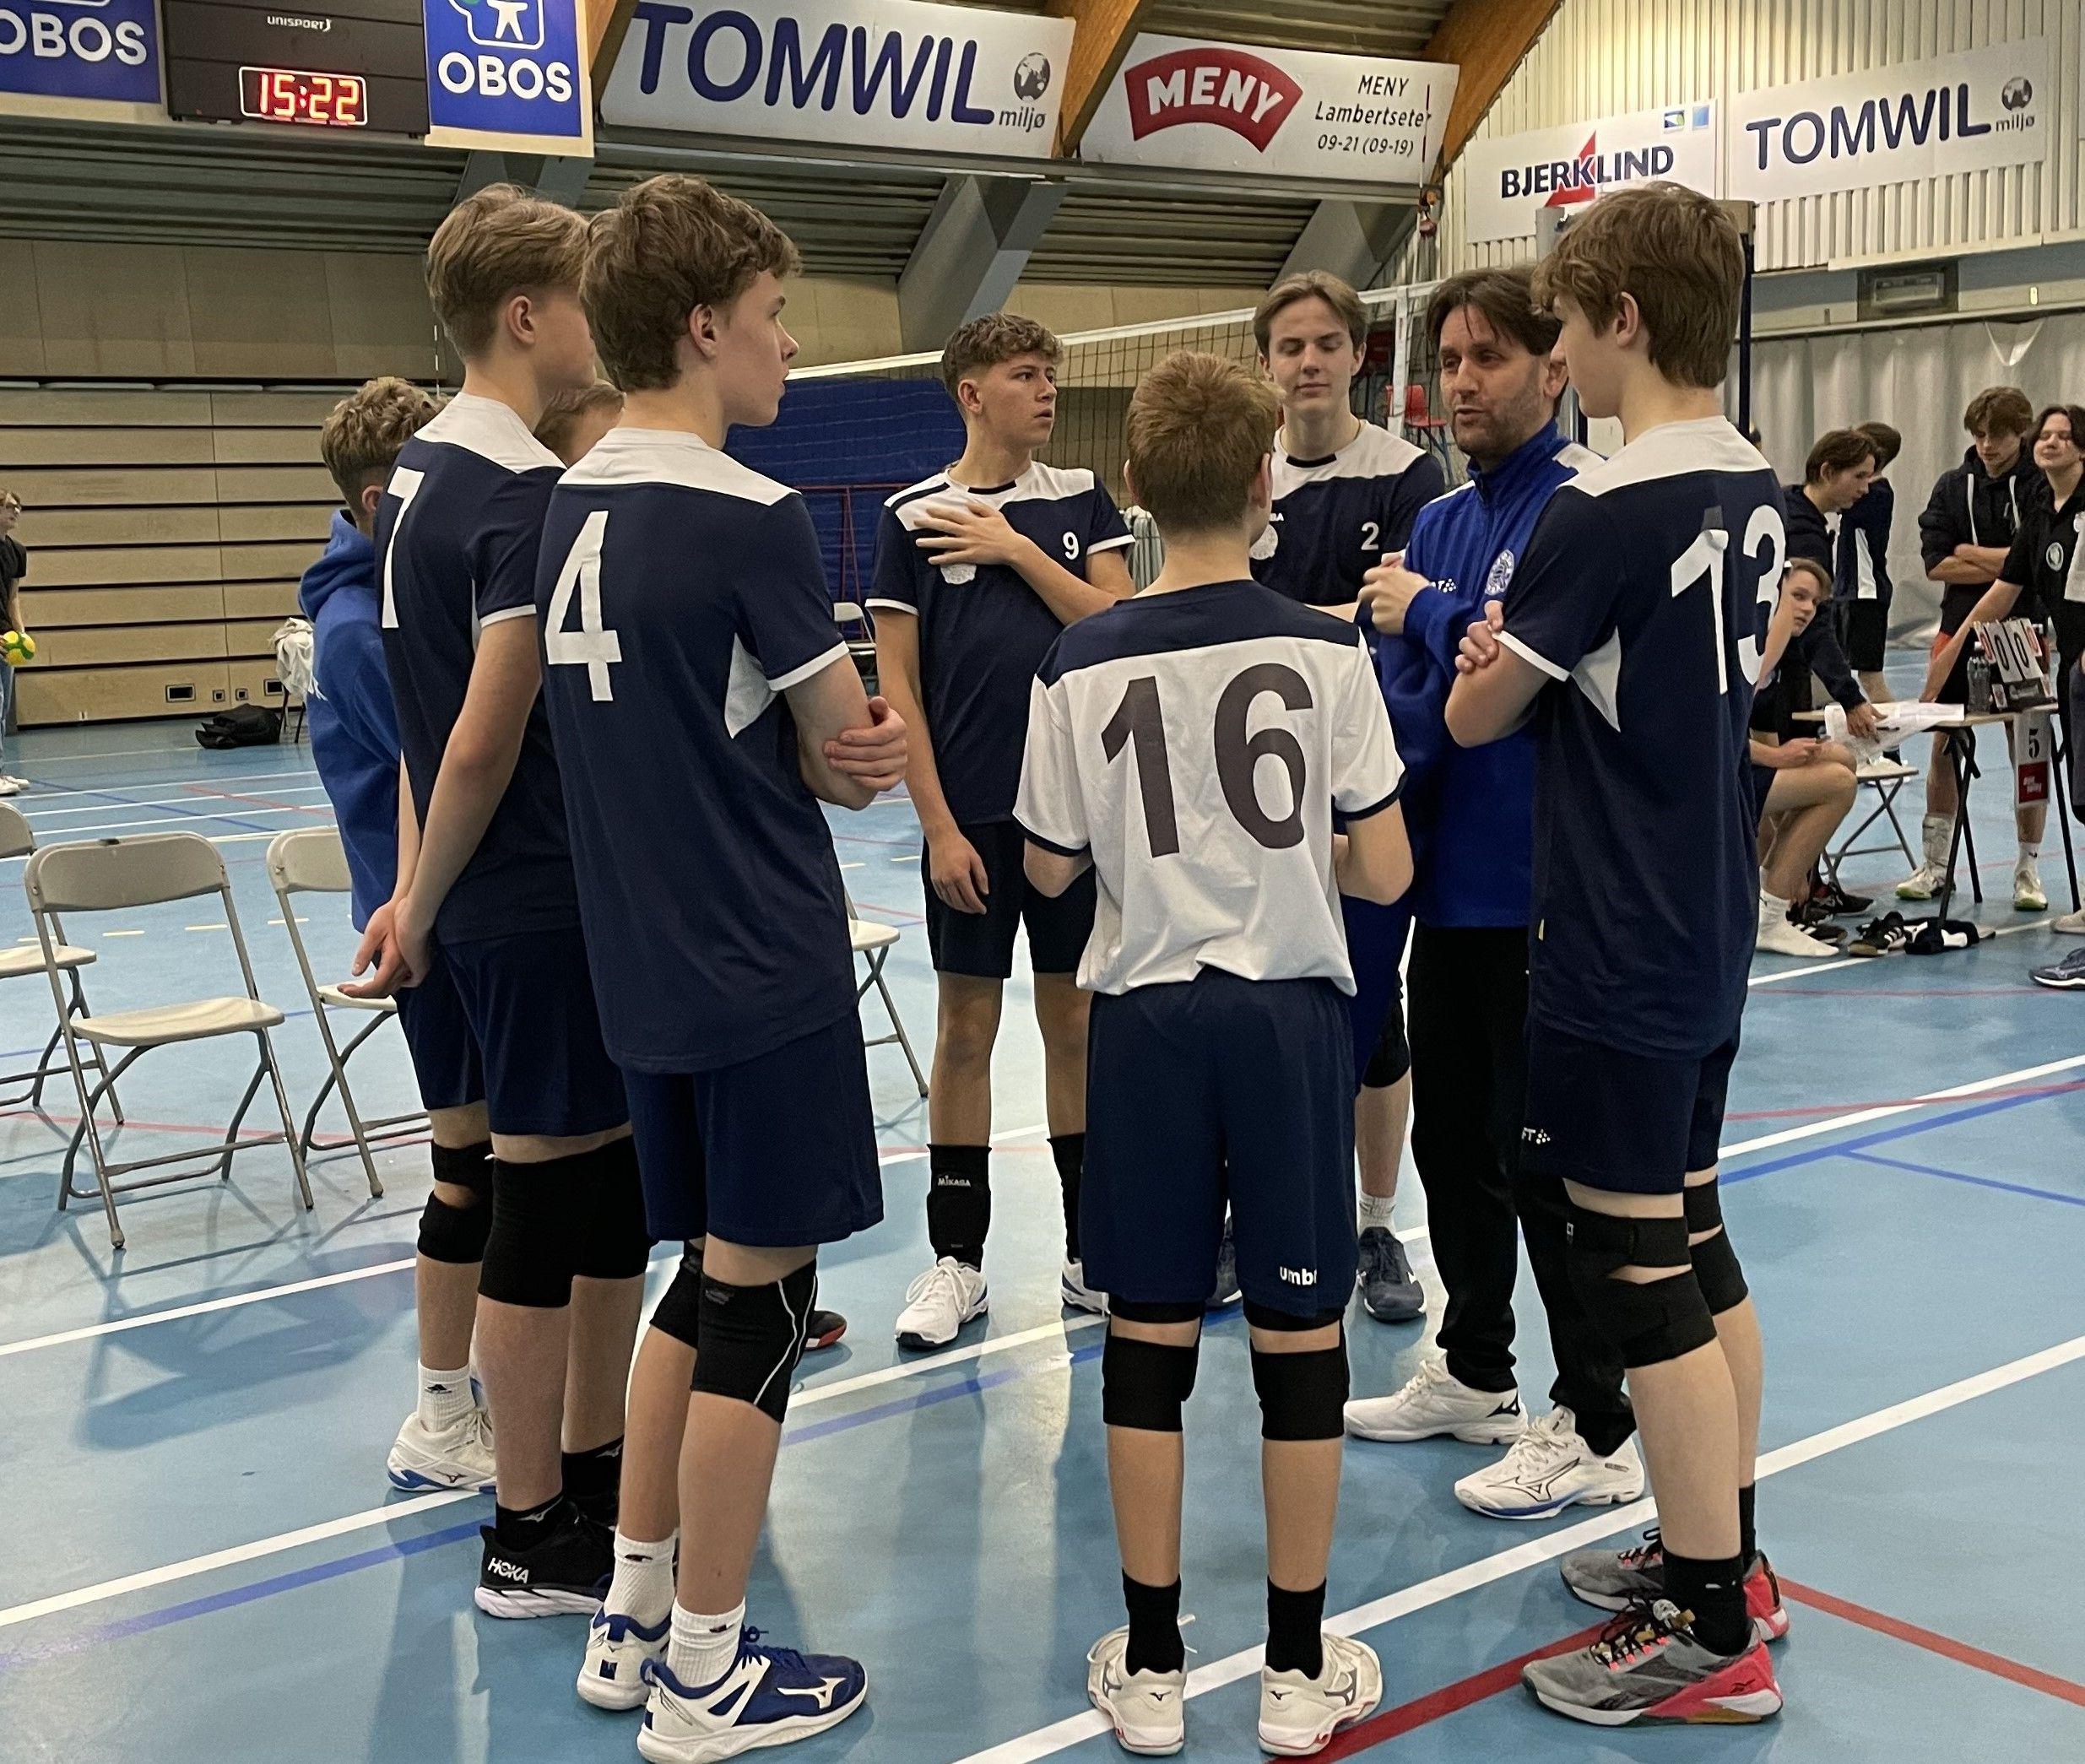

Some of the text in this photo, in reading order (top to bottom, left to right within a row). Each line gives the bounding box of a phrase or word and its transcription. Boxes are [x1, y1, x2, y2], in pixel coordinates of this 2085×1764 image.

[0, 8, 147, 65] OBOS
[437, 51, 572, 103] OBOS
[633, 3, 994, 124] TOMWIL
[1357, 74, 1410, 97] MENY
[259, 73, 360, 122] 15:22
[1146, 67, 1284, 124] MENY
[1318, 133, 1414, 158] 09-21 (09-19)
[1746, 83, 1991, 170] TOMWIL
[1501, 145, 1674, 198] BJERKLIND
[382, 466, 425, 629] 7
[1062, 531, 1079, 560] 9
[1361, 522, 1379, 550] 2
[544, 510, 622, 701] 4
[1671, 505, 1786, 695] 13
[1101, 663, 1313, 858] 16
[2028, 728, 2040, 759] 5
[487, 1557, 529, 1584] HOKA
